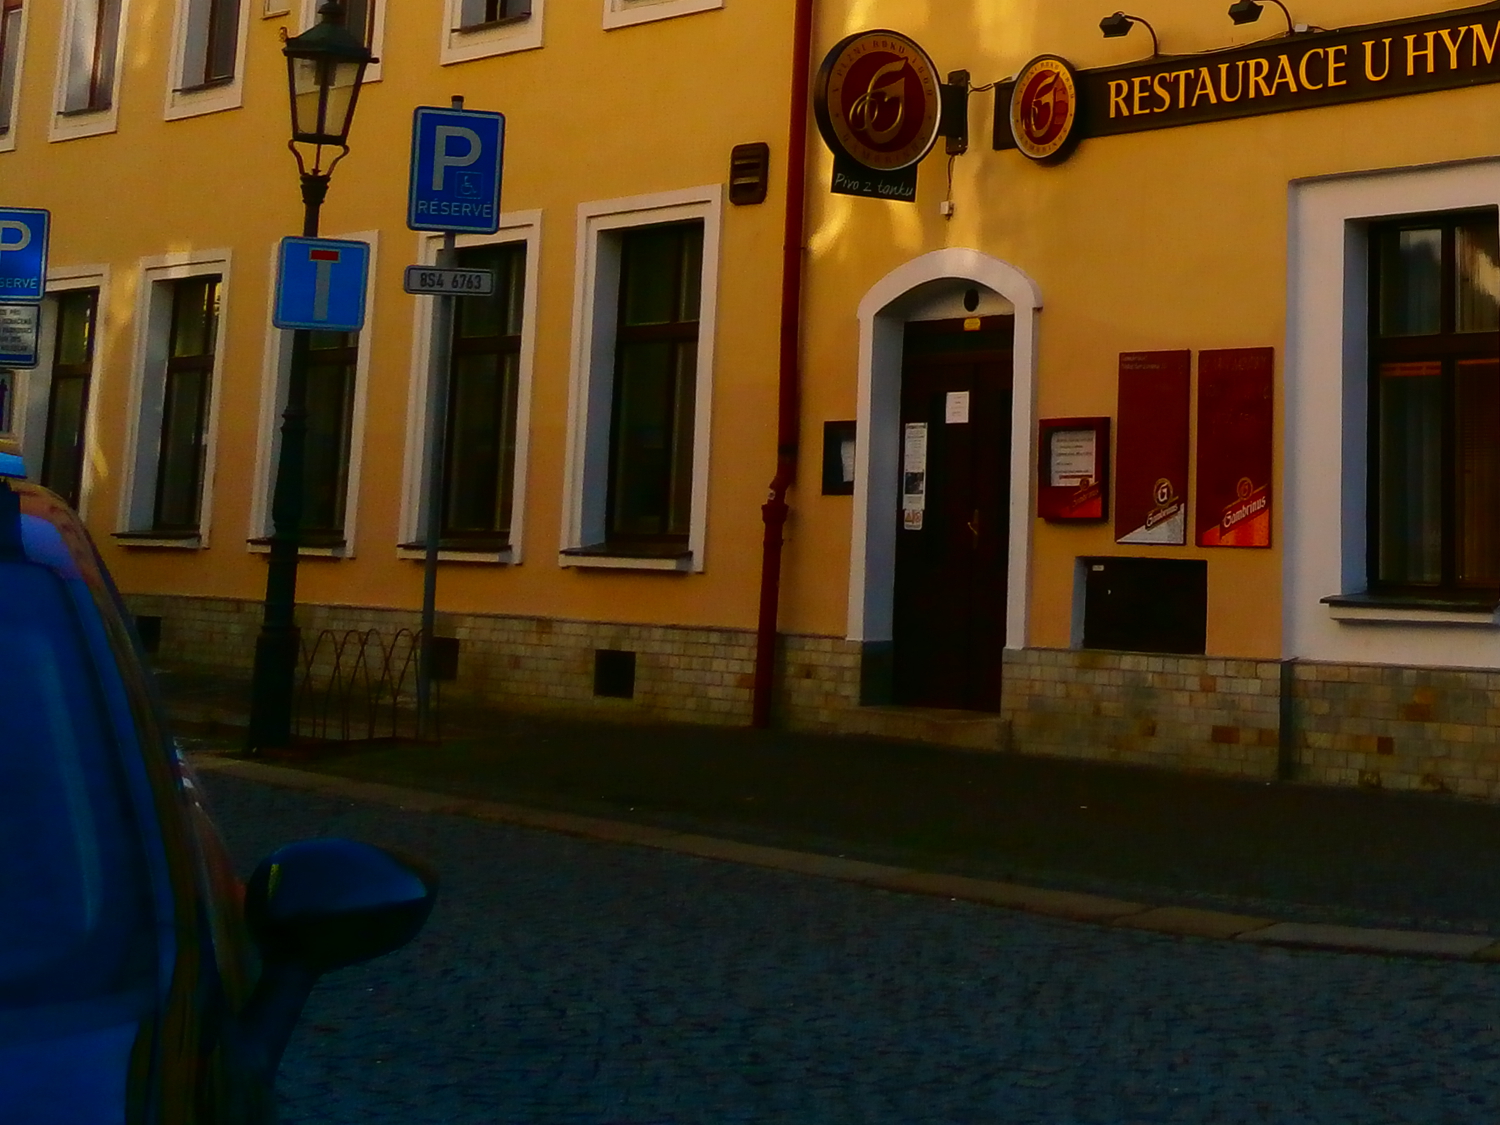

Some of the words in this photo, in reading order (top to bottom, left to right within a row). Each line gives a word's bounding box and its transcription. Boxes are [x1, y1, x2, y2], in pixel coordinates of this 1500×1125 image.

[1108, 45, 1347, 118] RESTAURACE
[1362, 38, 1395, 81] U
[431, 125, 482, 191] P
[834, 173, 860, 190] Pivo
[877, 179, 914, 196] tanku
[417, 197, 492, 218] RÉSERVÉ
[451, 274, 482, 290] 6763
[1146, 504, 1178, 526] Gambrinus
[1222, 495, 1266, 528] Gambrinus
